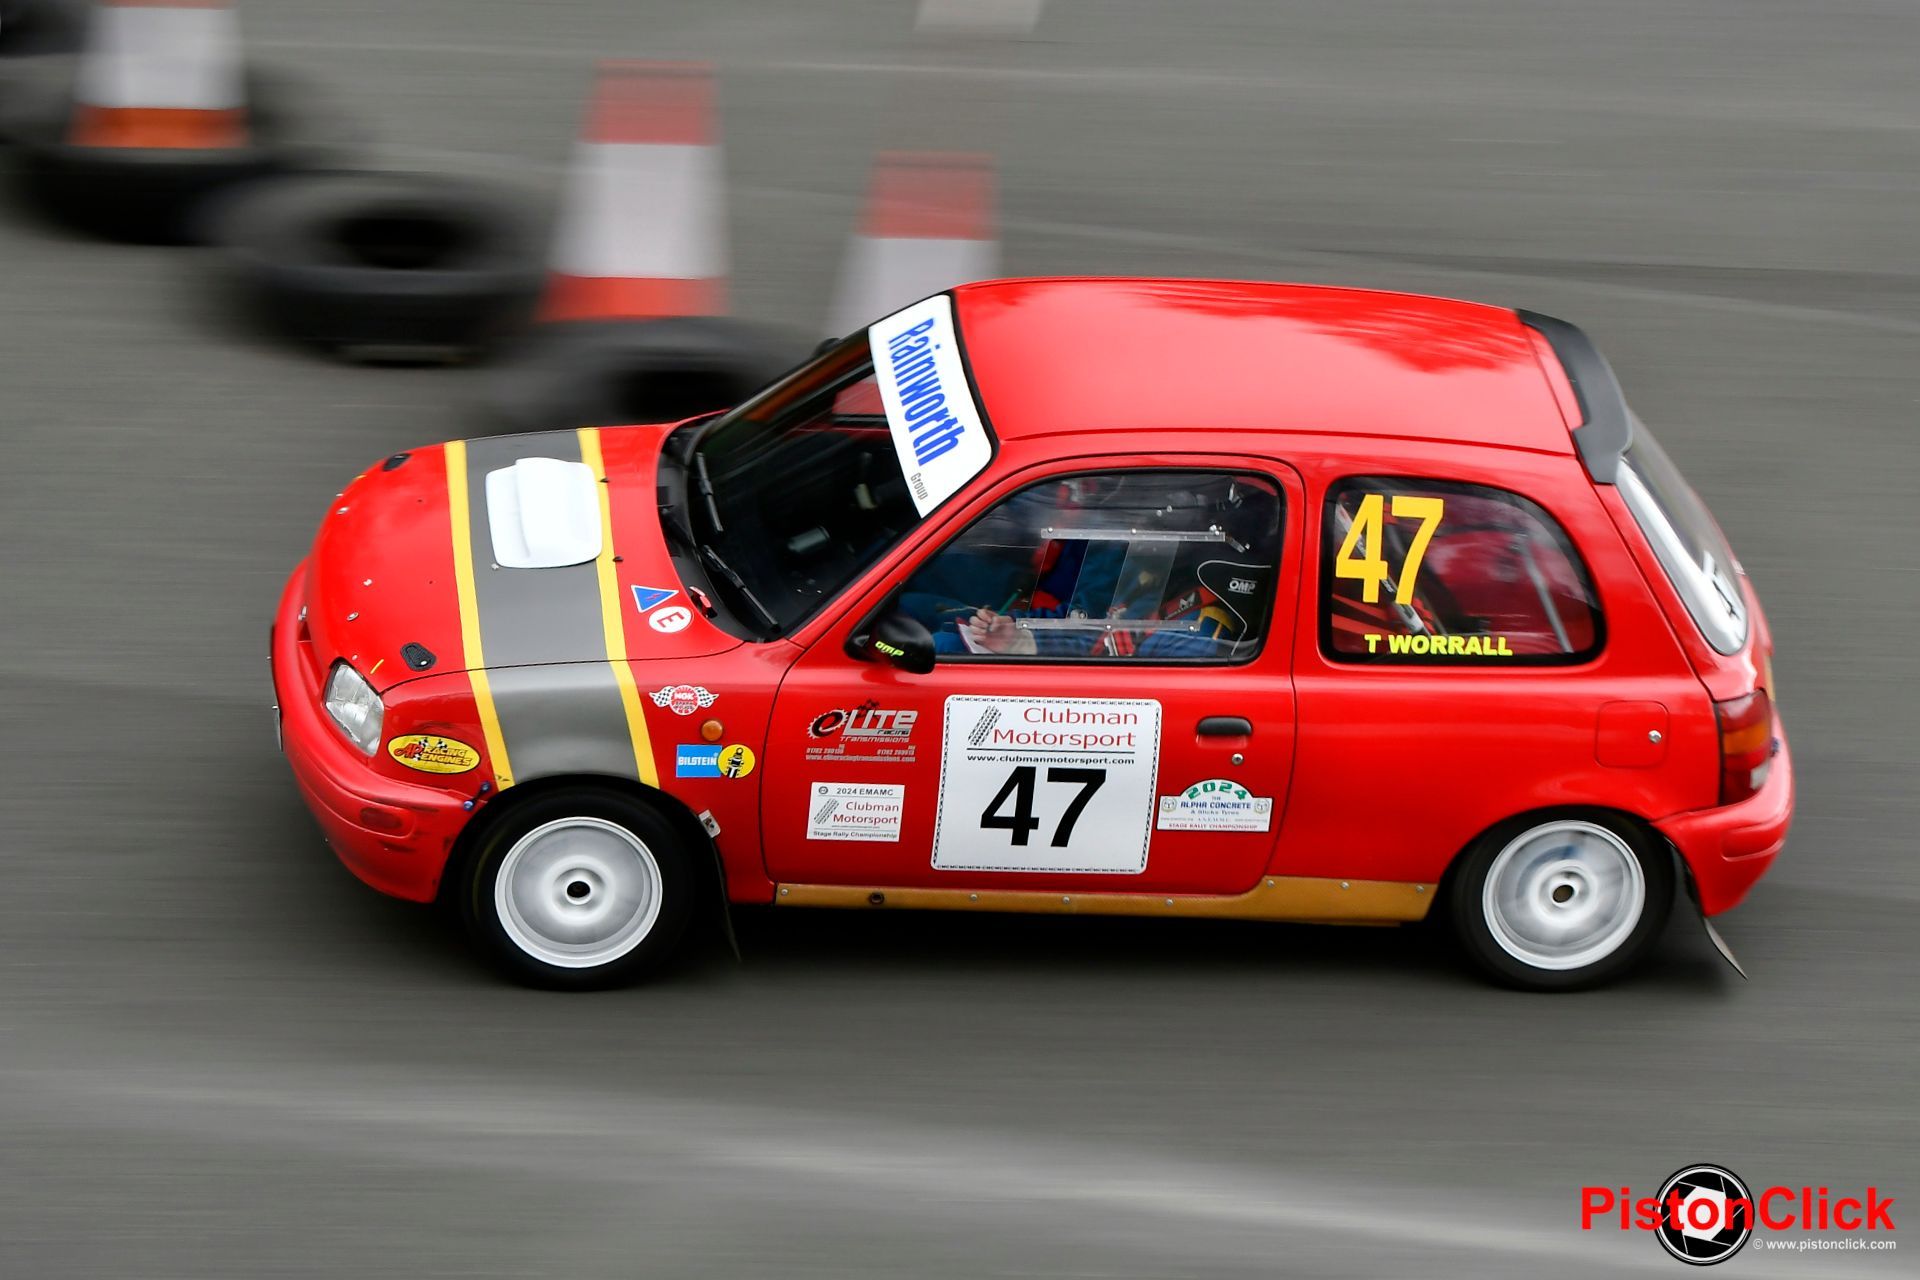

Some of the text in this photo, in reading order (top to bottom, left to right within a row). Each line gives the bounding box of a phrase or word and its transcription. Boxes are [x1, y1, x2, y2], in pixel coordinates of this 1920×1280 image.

[888, 317, 965, 467] Rainworth
[910, 472, 928, 500] Group
[1335, 493, 1444, 605] 47
[1229, 580, 1256, 592] OMP
[657, 611, 685, 628] E
[1364, 634, 1513, 656] T WORRALL
[1023, 707, 1138, 725] Clubman
[993, 729, 1136, 749] Motorsport
[423, 747, 467, 757] RACING
[420, 753, 472, 767] ENGINES
[678, 756, 718, 766] BILSTEIN
[967, 754, 1135, 766] www.clubmanmotorsport.com
[837, 787, 894, 796] 2024 EMAMC
[1186, 782, 1247, 800] 2024
[846, 801, 899, 812] Clubman
[980, 766, 1107, 848] 47
[1209, 801, 1252, 809] CONCRETE
[833, 814, 898, 826] Motorsport
